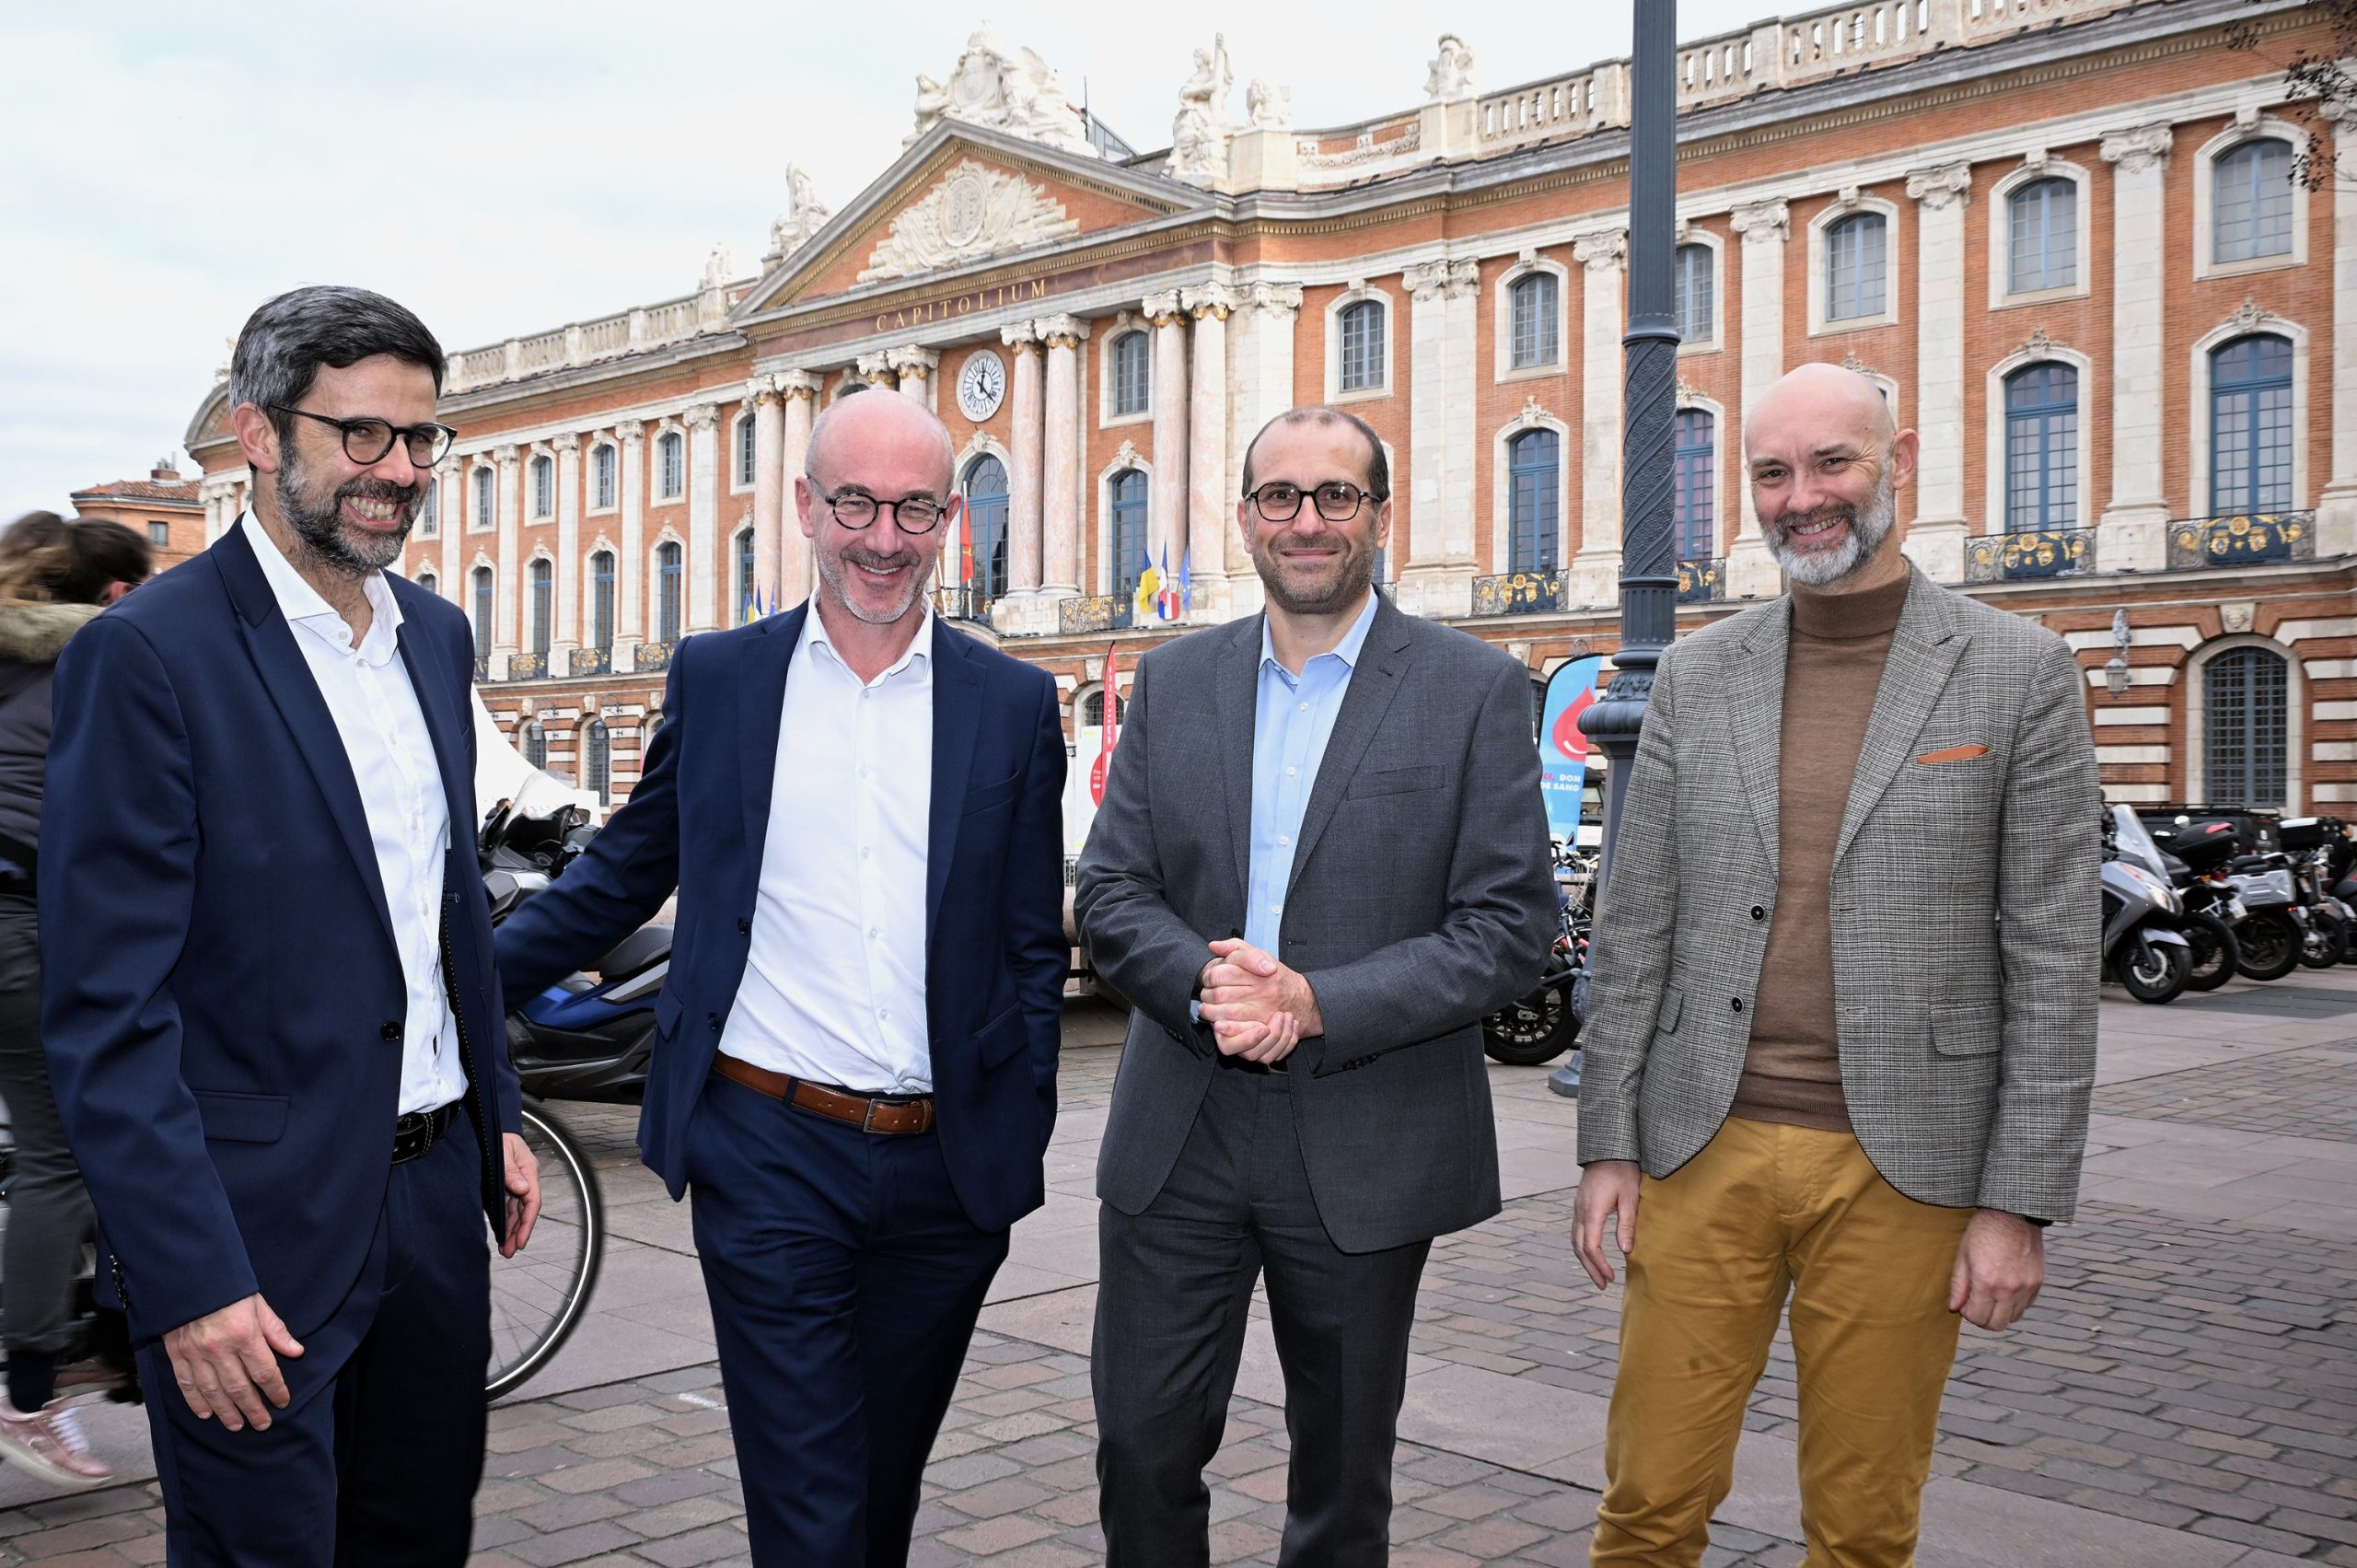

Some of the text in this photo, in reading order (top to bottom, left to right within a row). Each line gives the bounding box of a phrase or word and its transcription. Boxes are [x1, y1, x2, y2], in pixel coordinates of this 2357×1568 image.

[877, 279, 1046, 331] CAPITOLIUM
[1559, 773, 1581, 783] DON
[1553, 783, 1579, 792] SANG
